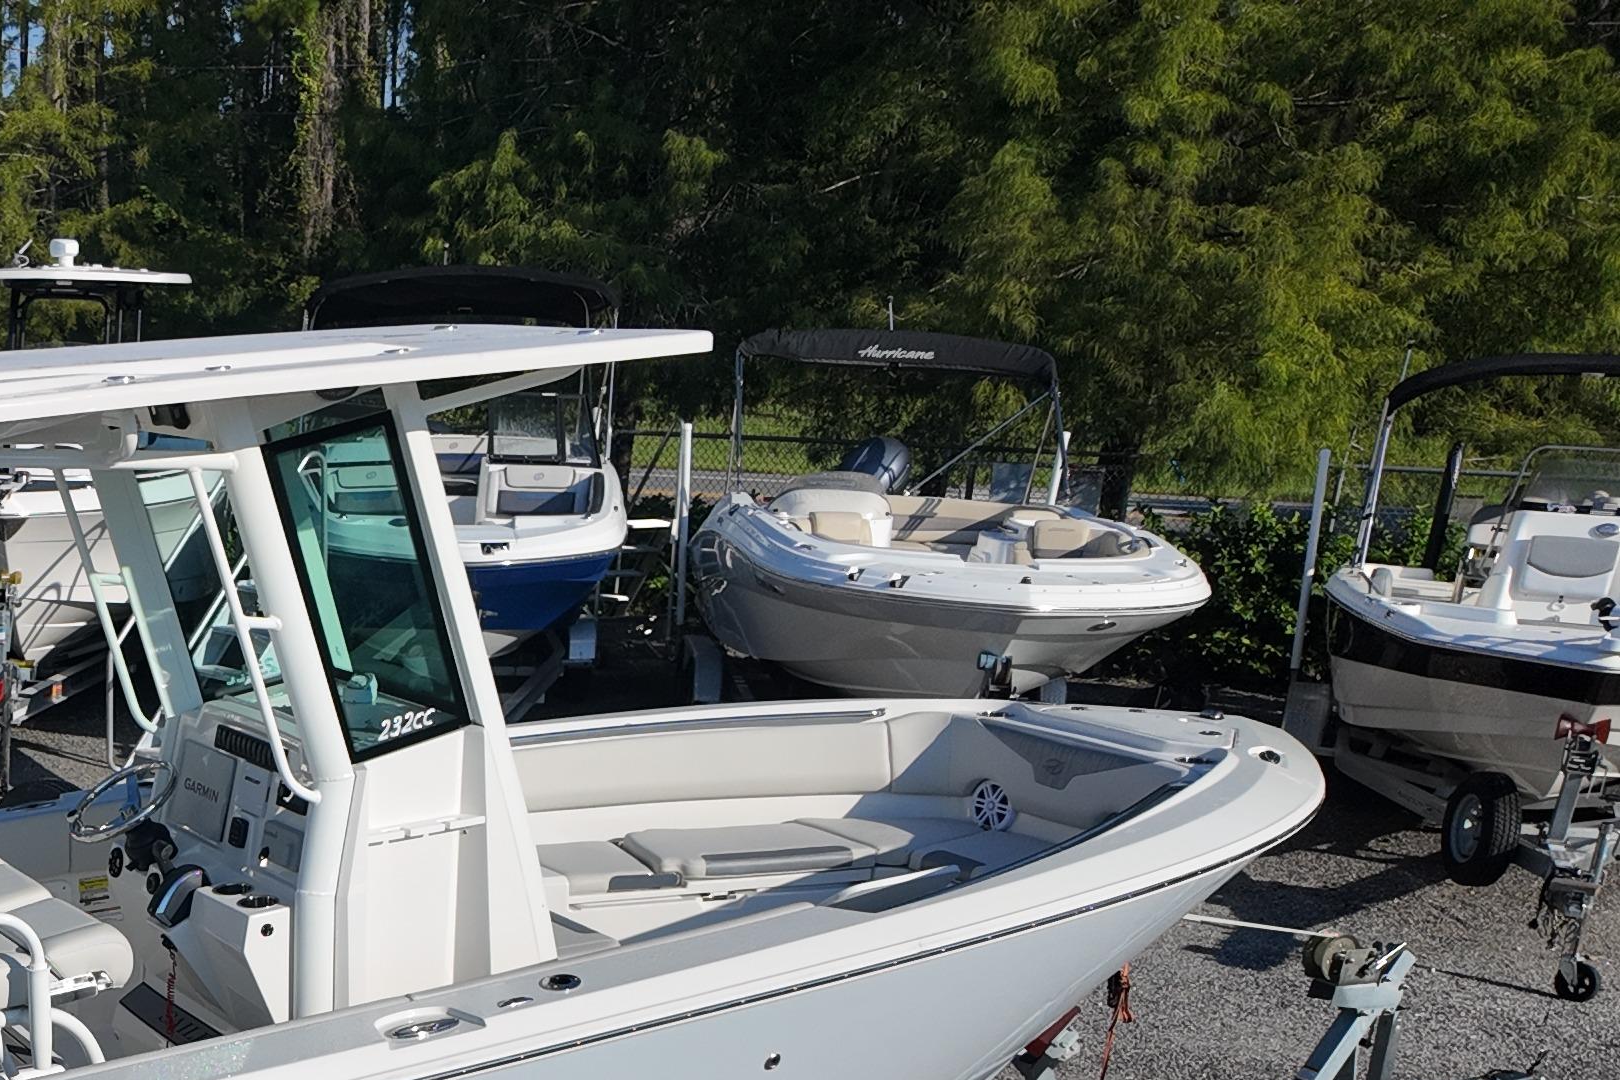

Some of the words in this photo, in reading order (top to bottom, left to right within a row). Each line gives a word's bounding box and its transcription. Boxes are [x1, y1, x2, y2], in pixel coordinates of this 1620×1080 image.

[858, 344, 935, 360] Hurricane
[378, 707, 436, 742] 232CC
[184, 777, 220, 804] GARMIN
